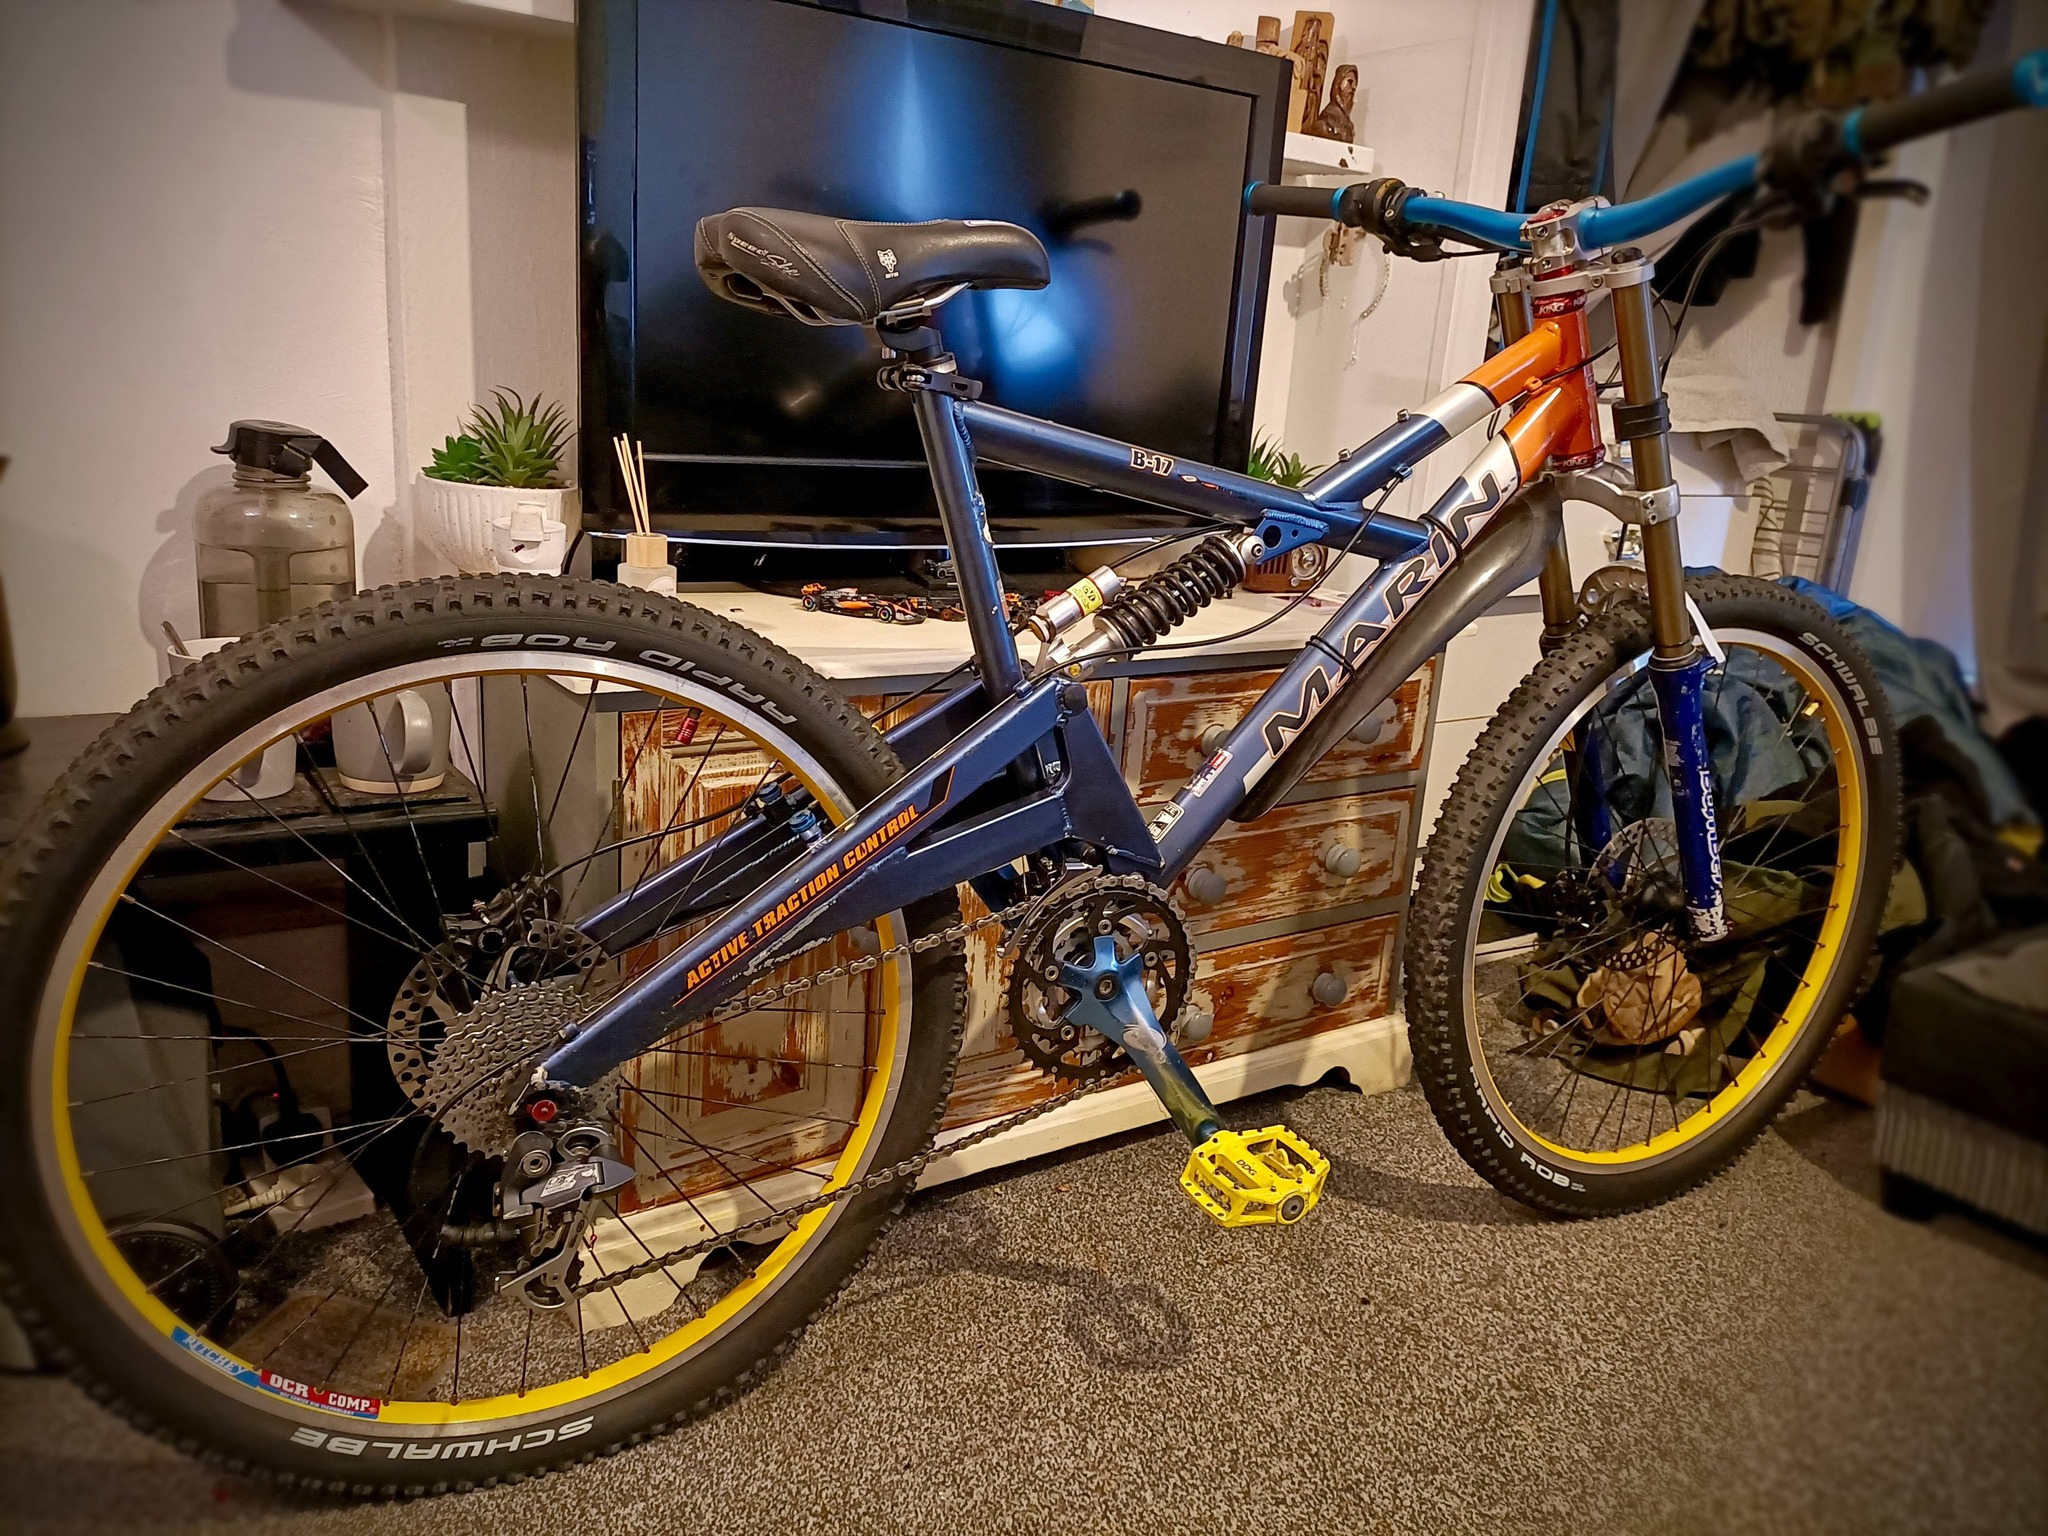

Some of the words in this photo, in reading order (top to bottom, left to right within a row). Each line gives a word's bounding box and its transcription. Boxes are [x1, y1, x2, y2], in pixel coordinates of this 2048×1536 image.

[1539, 302, 1565, 315] KING
[1129, 448, 1175, 477] B-17
[1563, 456, 1588, 467] KING
[1260, 469, 1504, 759] MARIN
[480, 633, 618, 652] ROB
[638, 649, 798, 726] RAPID
[1797, 631, 1884, 756] SCHWALBE
[686, 931, 750, 990] ACTIVE
[752, 865, 840, 936] TRACTION
[842, 803, 920, 869] CONTROL
[1469, 1065, 1515, 1149] RAPID
[1519, 1152, 1570, 1188] ROB
[182, 1335, 248, 1376] RITCHEY
[270, 1374, 309, 1398] OCR
[328, 1393, 370, 1412] COMP
[289, 1414, 595, 1461] SCHWALBE
